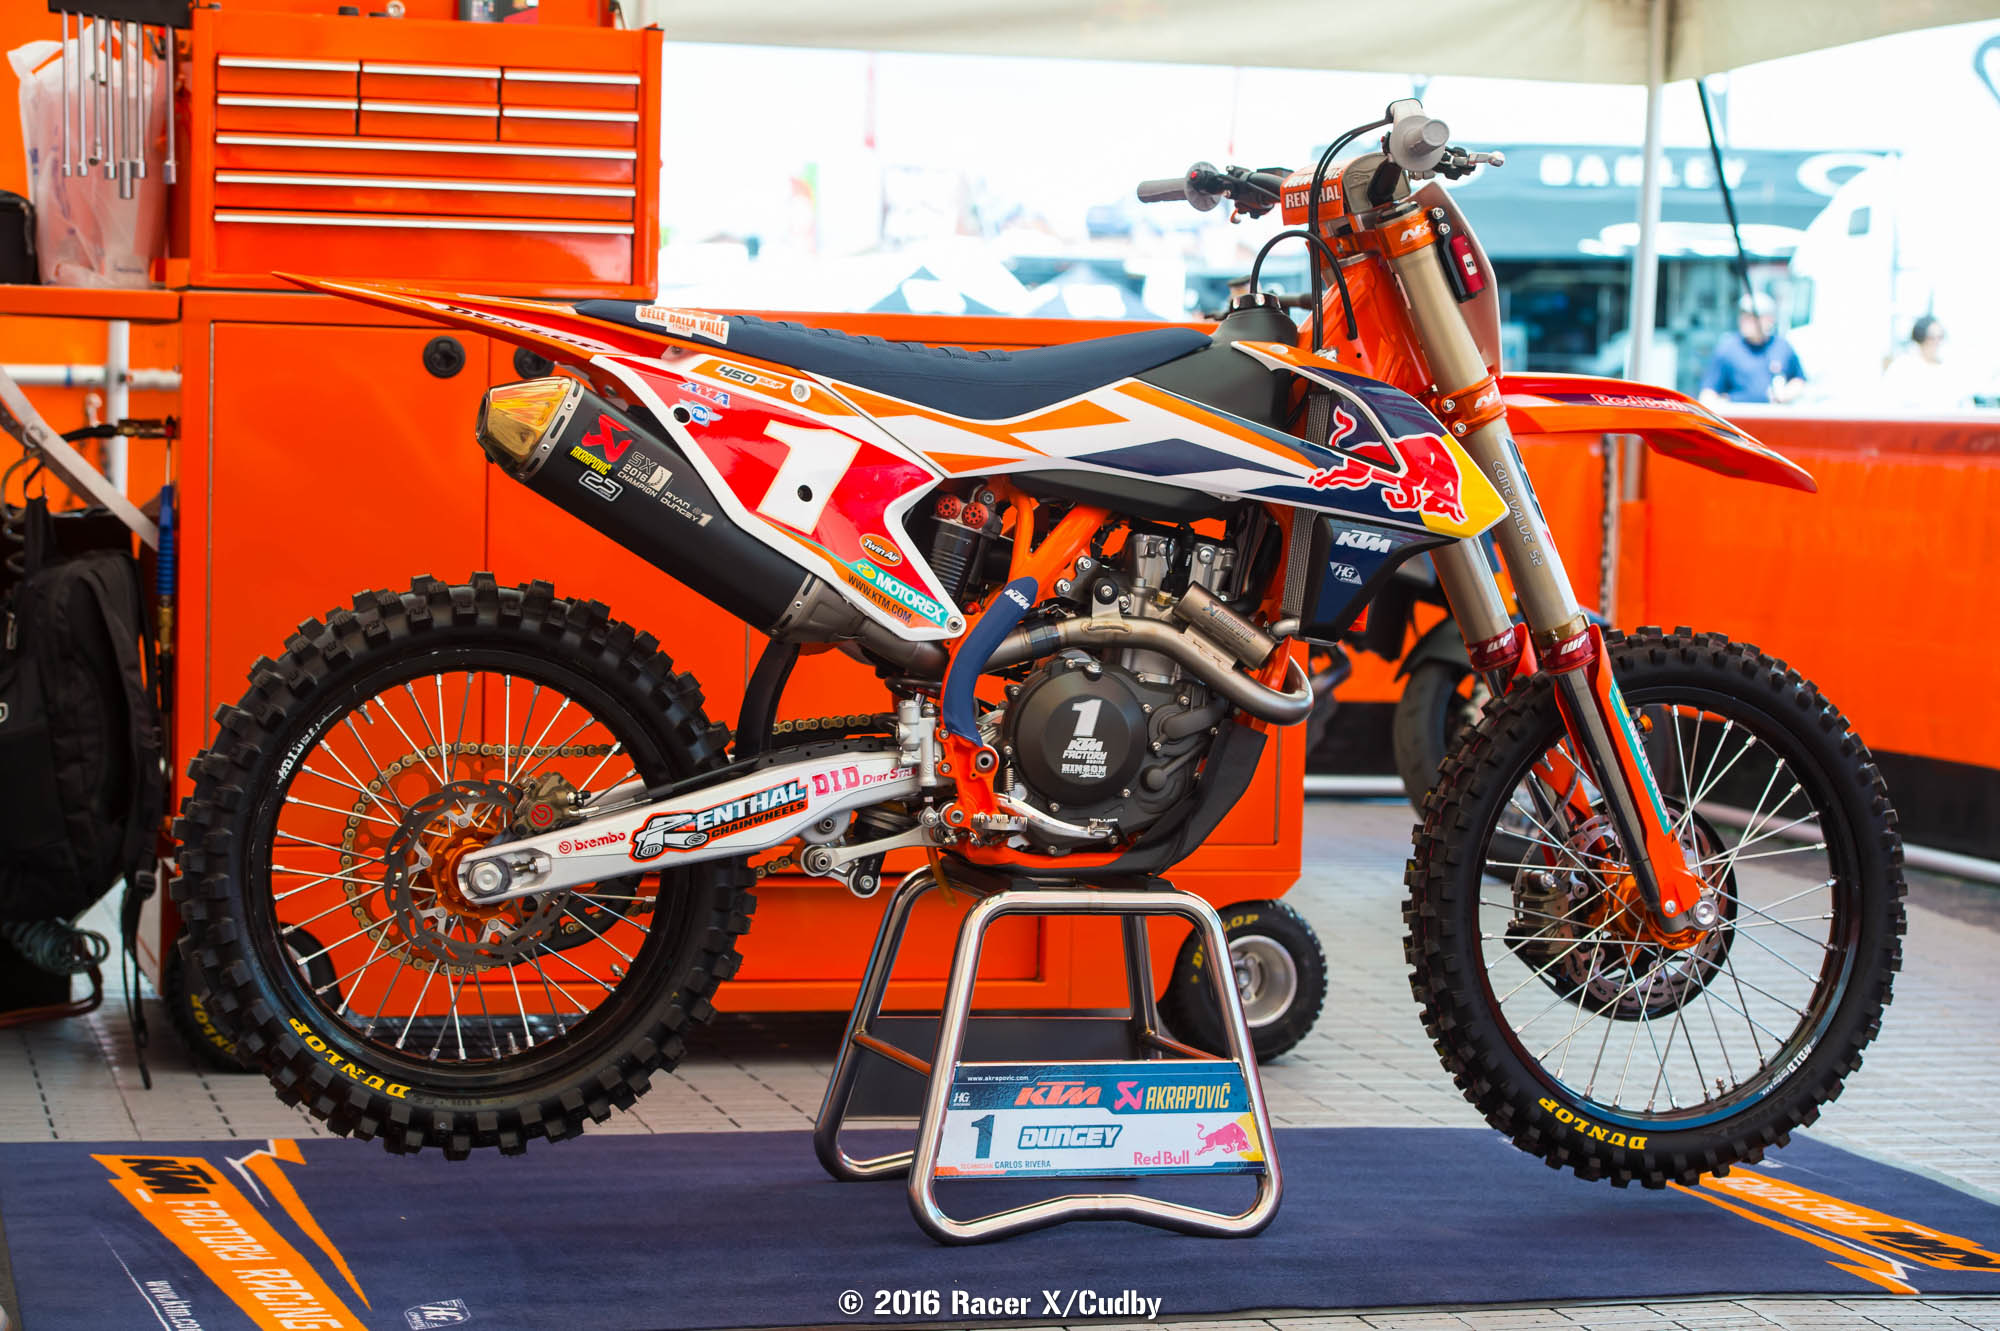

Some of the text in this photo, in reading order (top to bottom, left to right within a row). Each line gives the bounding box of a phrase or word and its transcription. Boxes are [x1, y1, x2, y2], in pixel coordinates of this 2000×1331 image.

[1285, 184, 1341, 208] RENHAL
[669, 314, 696, 328] DALLA
[700, 321, 725, 337] VALLE
[719, 366, 758, 384] 450
[622, 464, 649, 482] 2016
[628, 451, 656, 474] SX
[617, 471, 658, 498] CHAMPION
[757, 420, 862, 534] 1
[660, 498, 699, 522] DUNGEY
[664, 491, 690, 509] RYAN
[865, 538, 899, 562] Twin Air
[1335, 530, 1392, 553] KTM
[1335, 565, 1355, 578] HG
[848, 574, 912, 623] WWW.KTM.COM
[876, 572, 944, 622] MOTOREX
[1004, 589, 1031, 610] KTM
[1072, 699, 1102, 737] 1
[1062, 750, 1108, 760] FACTORY
[1067, 737, 1104, 751] KTM
[863, 774, 888, 785] DIRT
[711, 801, 805, 838] CHAINWHEELS
[574, 832, 626, 851] brembo
[288, 1018, 412, 1099] DUNLOP
[953, 1092, 971, 1103] HG
[1014, 1081, 1102, 1106] KTM
[1538, 1097, 1648, 1150] DUNLOP
[971, 1114, 1122, 1159] 1 DUNGEY
[994, 1160, 1022, 1168] CARLOS
[1025, 1160, 1051, 1168] RIVERA
[1134, 1151, 1190, 1166] Red Bull
[120, 1158, 218, 1194] KTM
[163, 1200, 278, 1261] FACTORY
